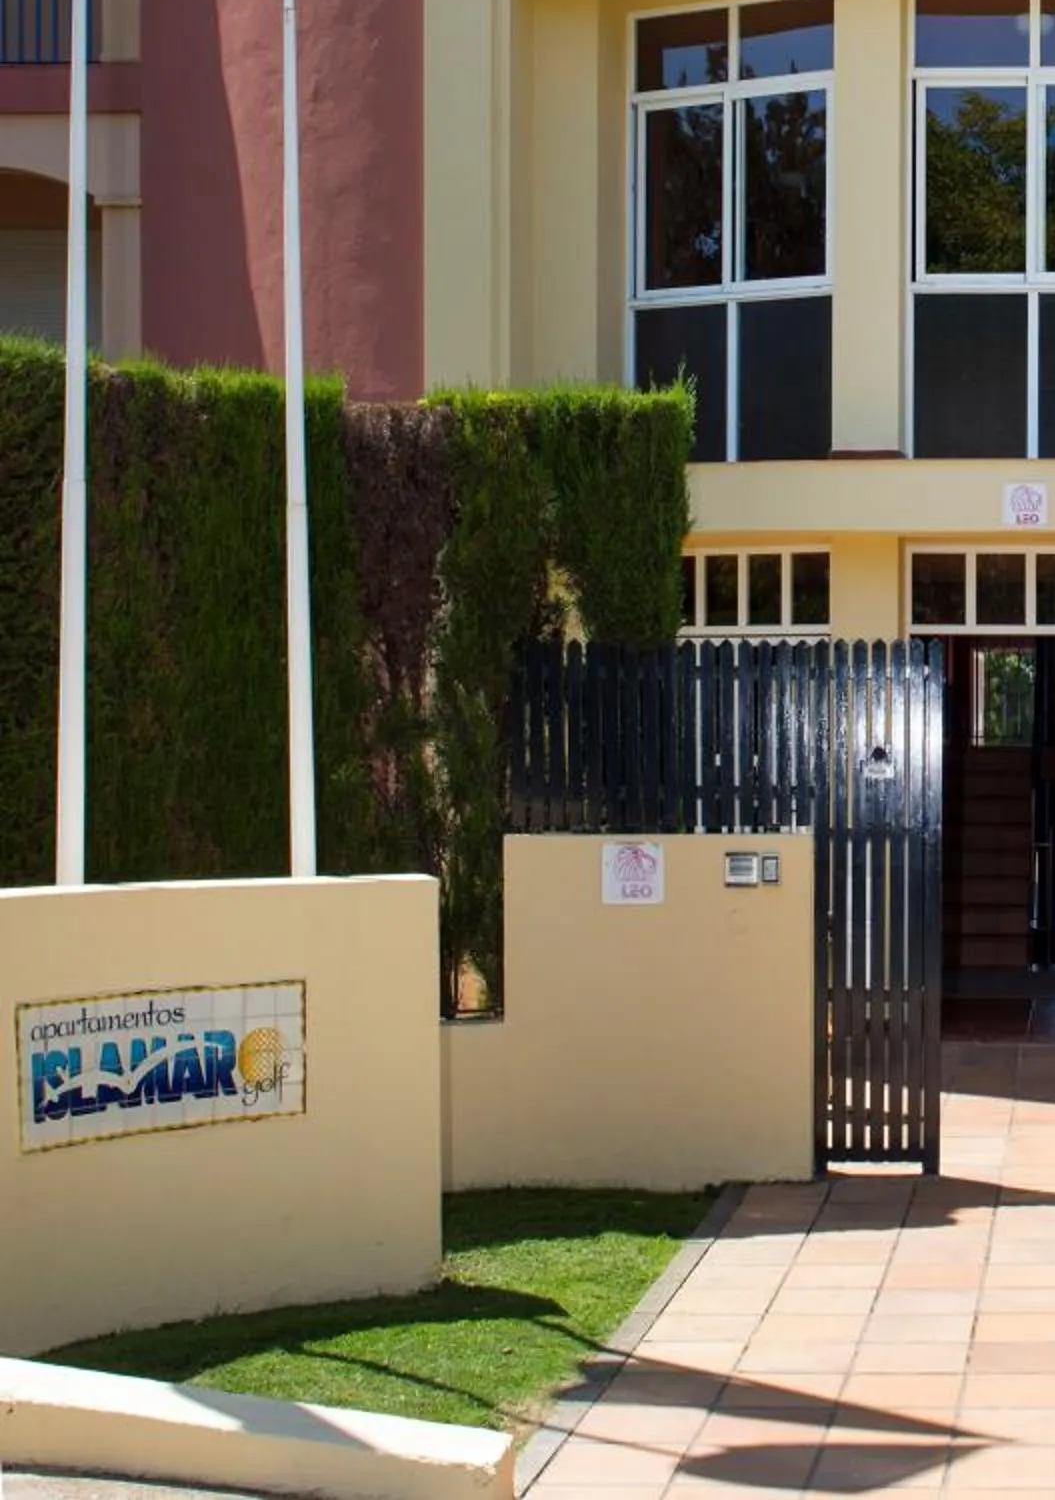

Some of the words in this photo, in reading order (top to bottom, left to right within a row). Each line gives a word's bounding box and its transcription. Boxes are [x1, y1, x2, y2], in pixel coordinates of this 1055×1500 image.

[30, 1000, 186, 1050] apartamentos
[31, 1029, 238, 1124] ISLAMAR
[241, 1060, 290, 1107] golf
